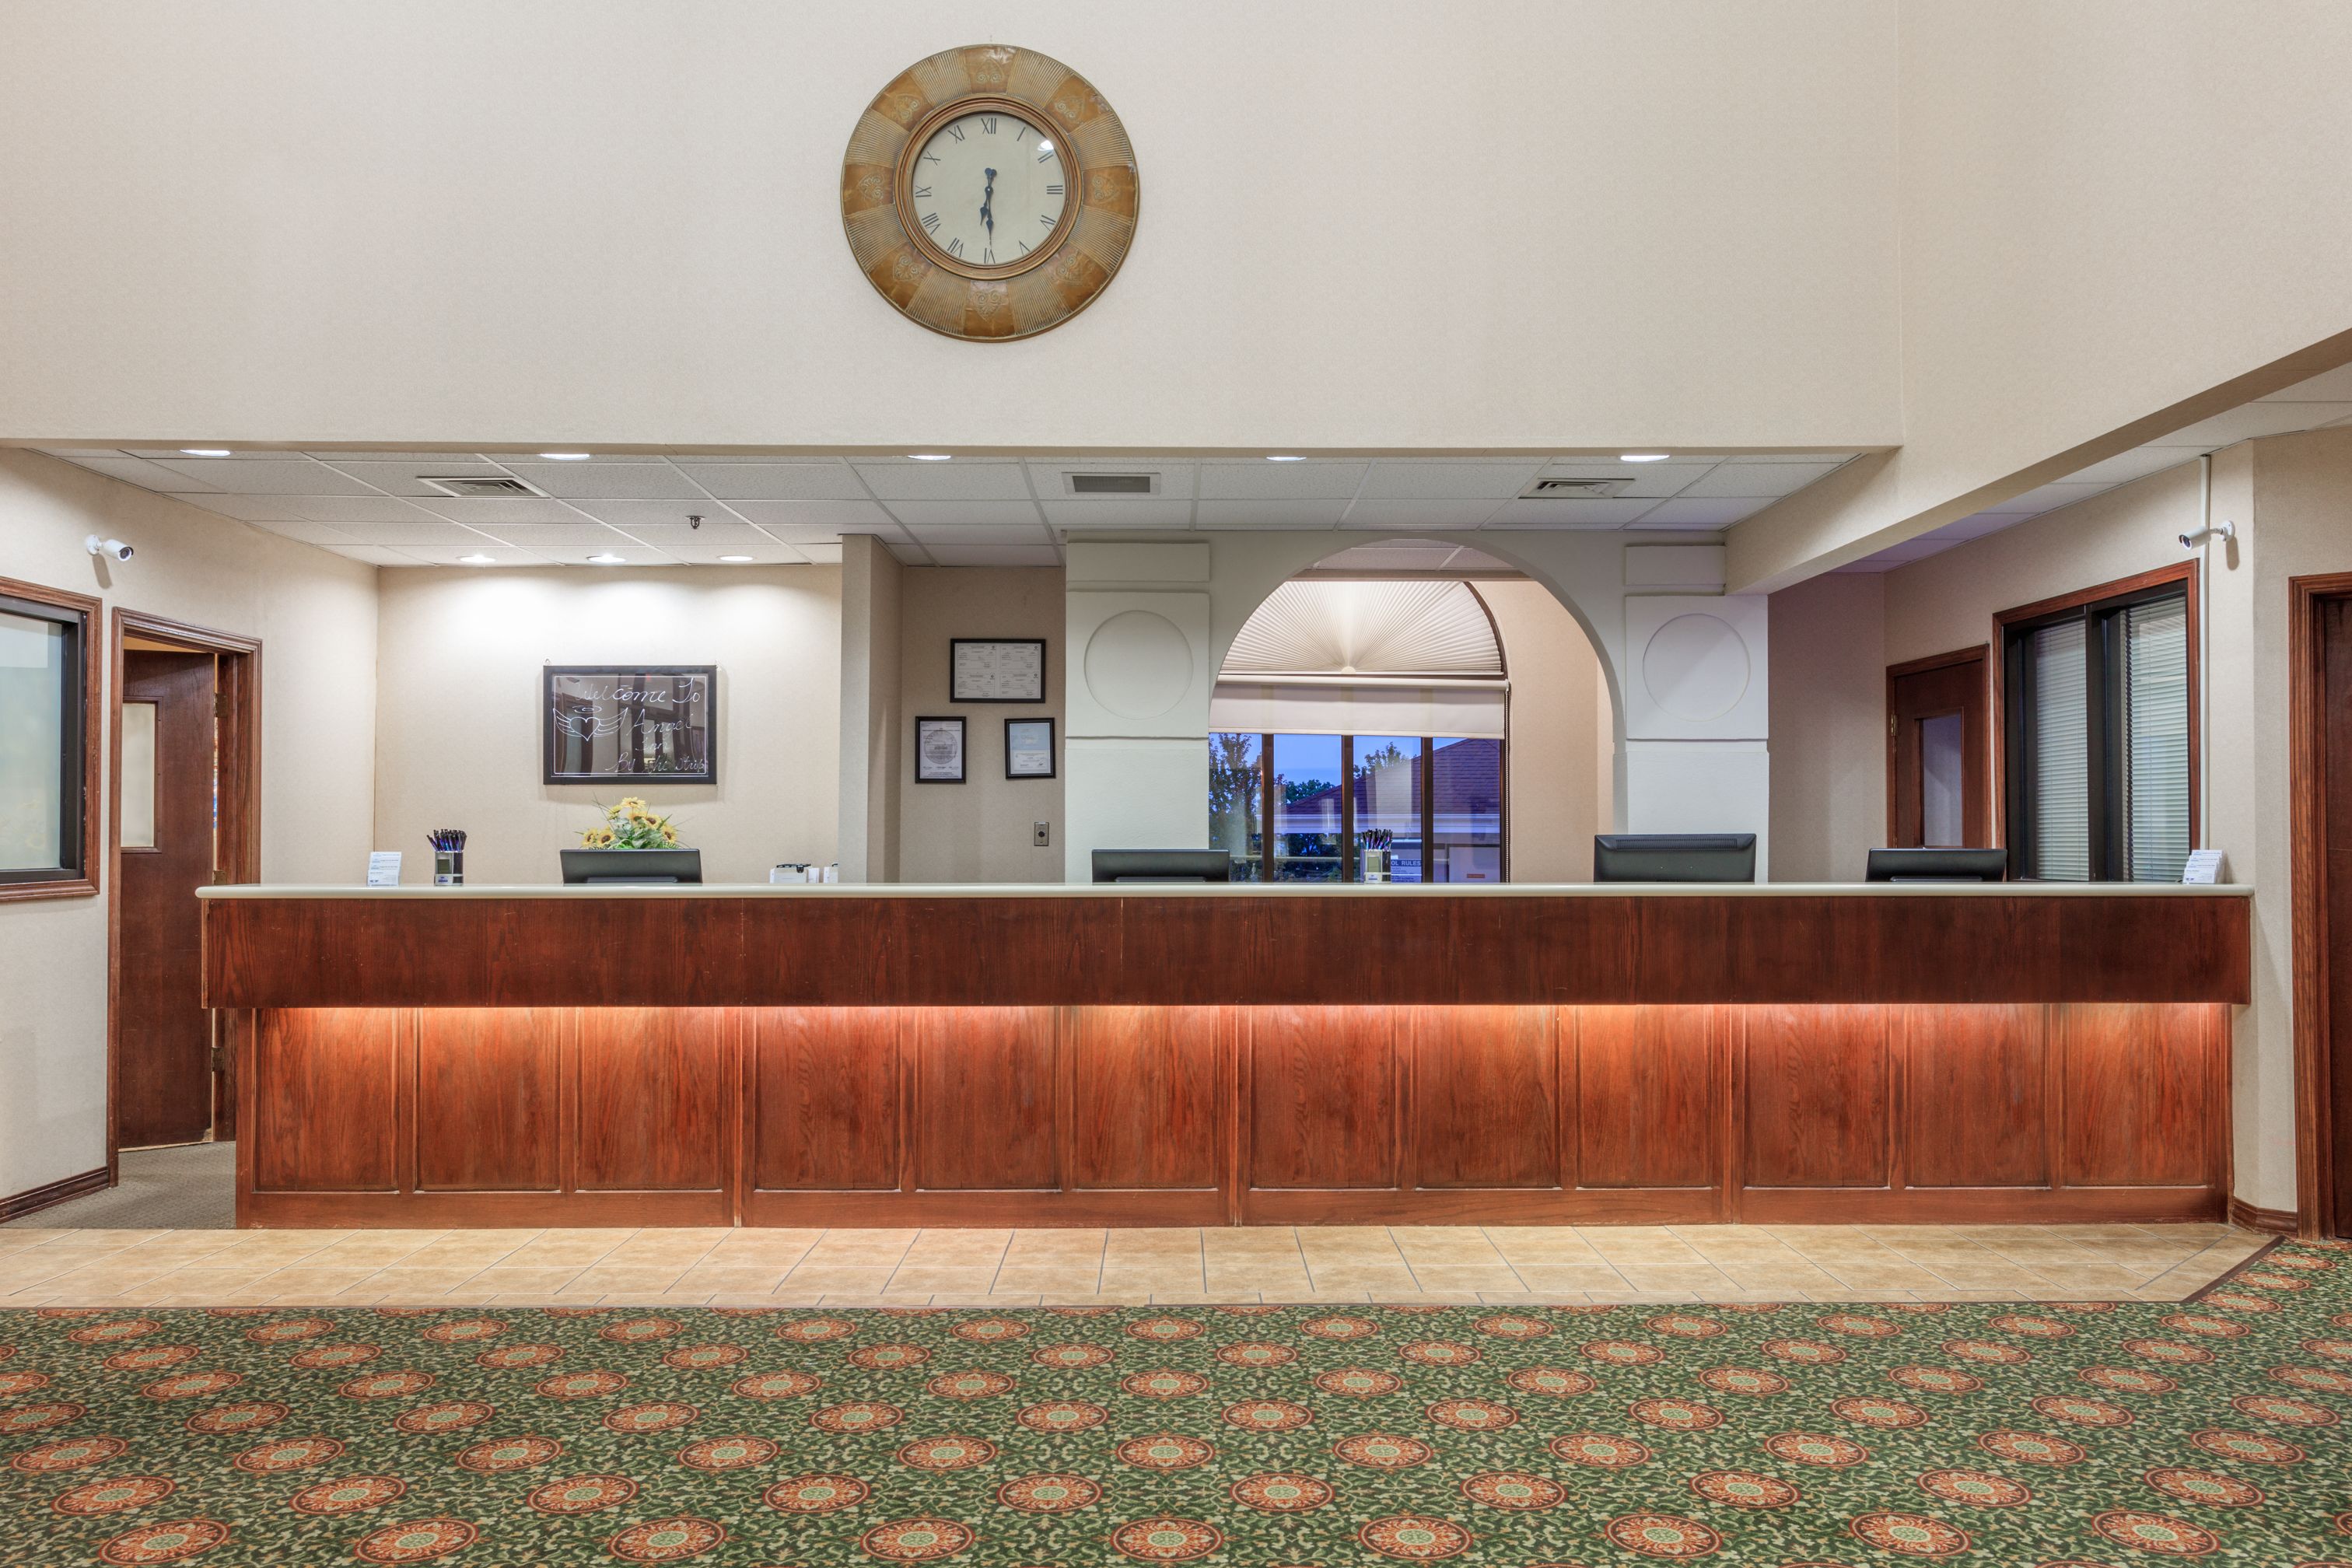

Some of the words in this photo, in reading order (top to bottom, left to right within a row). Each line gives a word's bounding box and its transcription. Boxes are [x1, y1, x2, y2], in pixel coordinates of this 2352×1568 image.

[947, 124, 965, 144] XI
[981, 117, 997, 135] XII
[1016, 127, 1027, 142] I
[923, 151, 941, 166] X
[1038, 150, 1054, 163] II
[915, 185, 932, 198] IX
[1046, 185, 1063, 194] III
[921, 212, 941, 235] VIII
[1039, 215, 1056, 232] IV
[947, 237, 964, 257] VII
[984, 247, 996, 264] VI
[1018, 240, 1031, 256] V
[576, 682, 667, 702] Welcome
[672, 677, 701, 703] To
[625, 708, 695, 739] Angel
[605, 751, 636, 772] By
